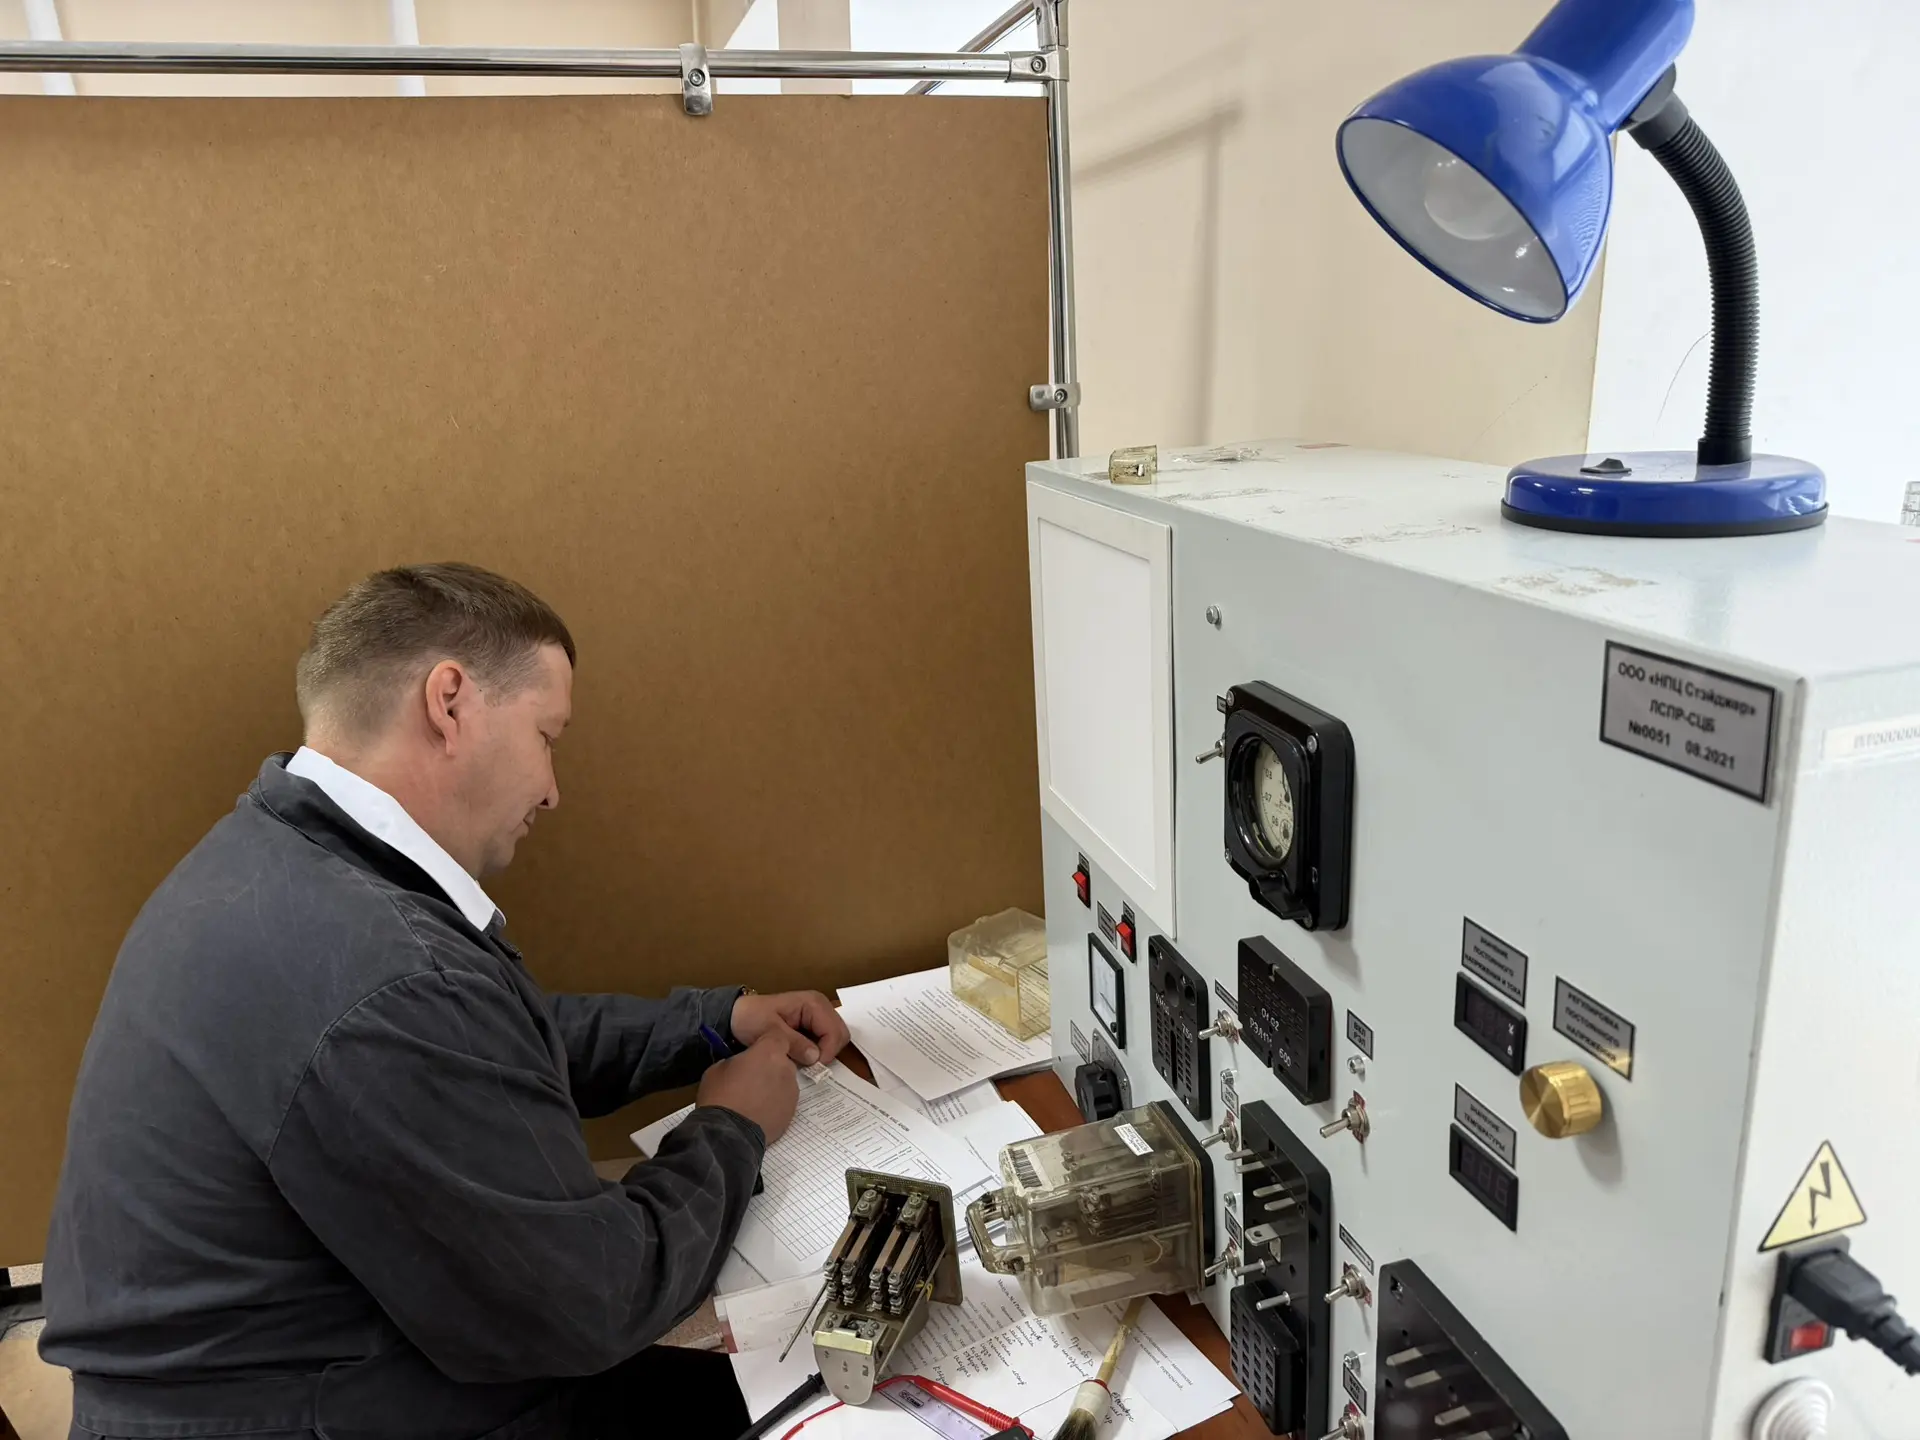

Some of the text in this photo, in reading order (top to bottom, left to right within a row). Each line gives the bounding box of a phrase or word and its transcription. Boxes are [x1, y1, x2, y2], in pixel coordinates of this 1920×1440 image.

[1618, 662, 1646, 681] ООО
[1649, 672, 1682, 695] «НПЦ
[1628, 720, 1736, 770] №0051 08.2021
[1278, 1047, 1292, 1068] 600
[1463, 1112, 1506, 1152] ТЕМПЕРАТУРЫ
